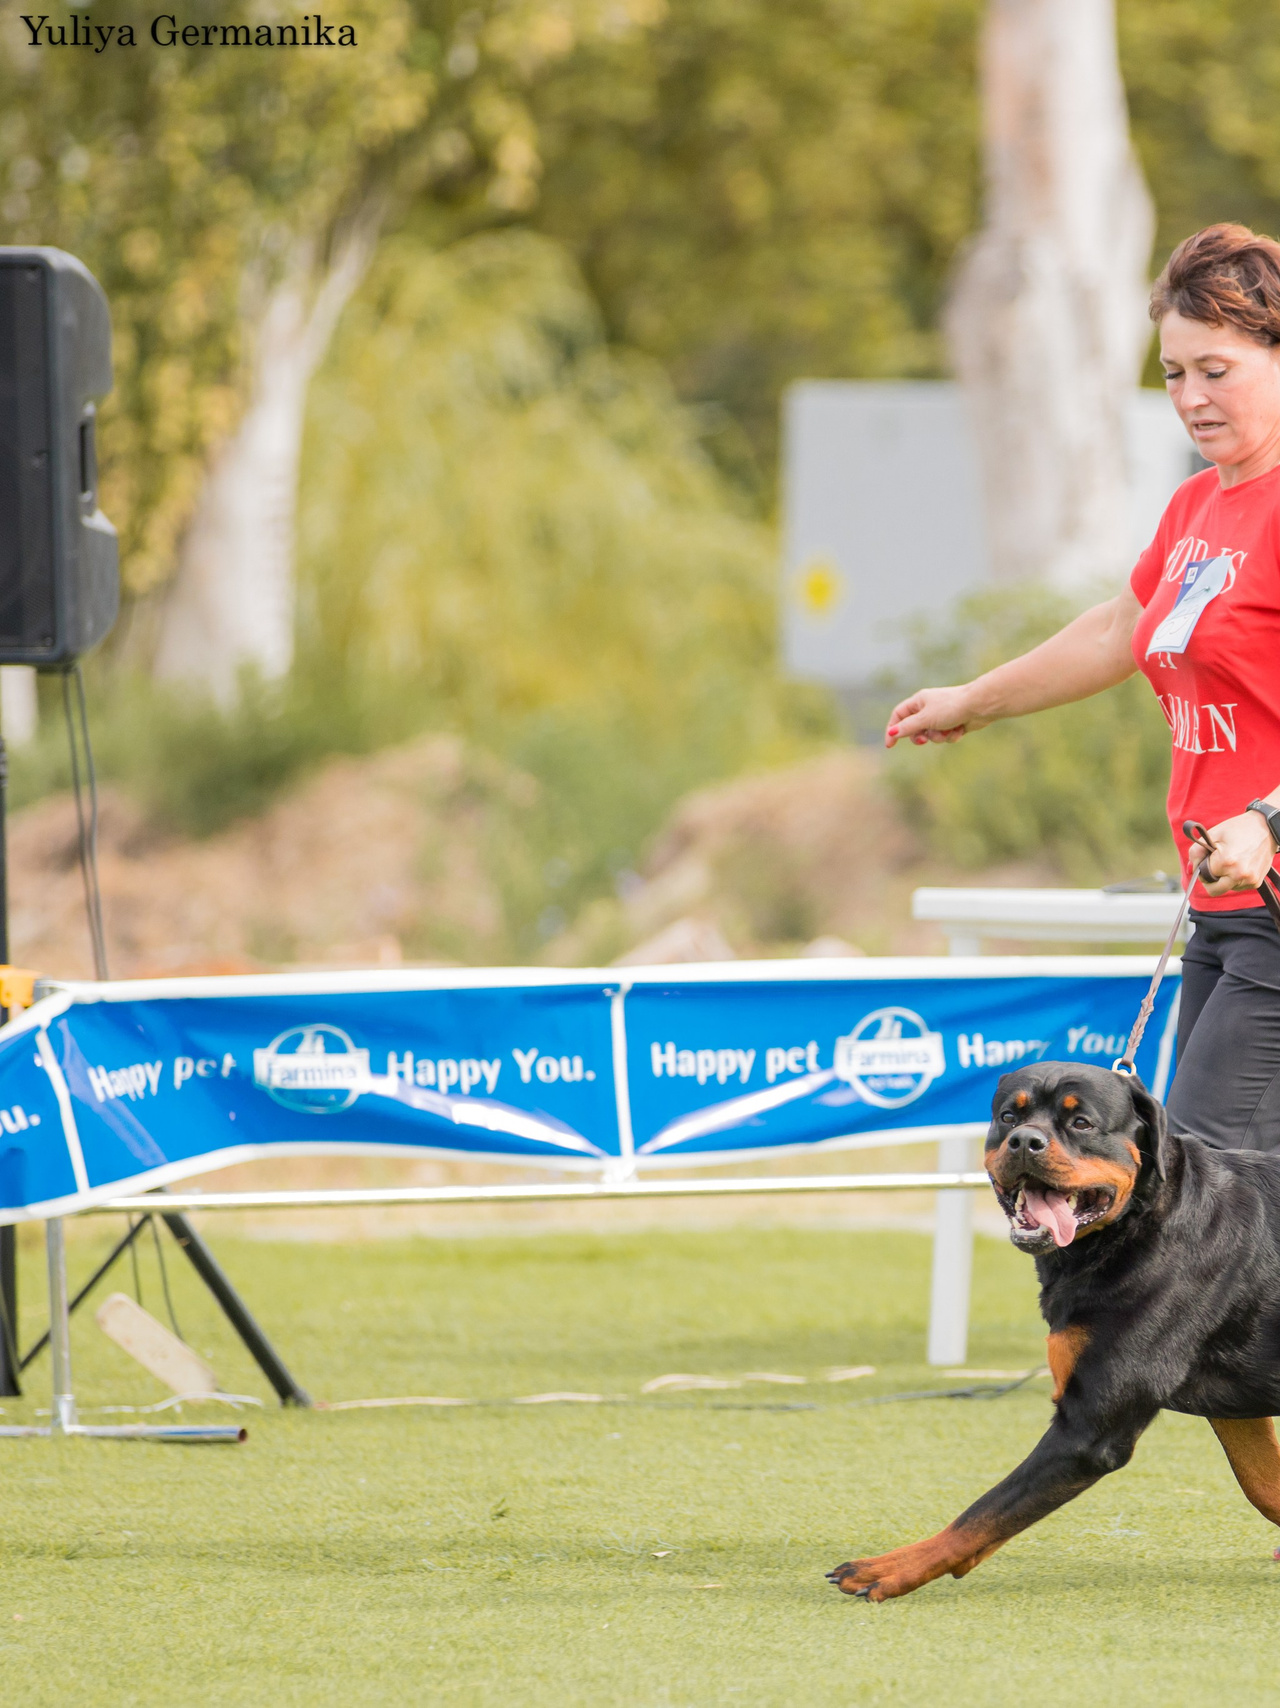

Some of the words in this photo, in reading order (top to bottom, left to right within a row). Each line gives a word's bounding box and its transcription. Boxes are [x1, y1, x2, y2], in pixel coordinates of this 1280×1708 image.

[1220, 547, 1249, 595] S
[650, 1041, 756, 1085] Happy
[765, 1040, 824, 1084] pet
[1067, 1025, 1128, 1055] You
[87, 1064, 163, 1103] Happy
[173, 1052, 237, 1090] pet
[387, 1051, 501, 1095] Happy
[512, 1048, 596, 1084] You.
